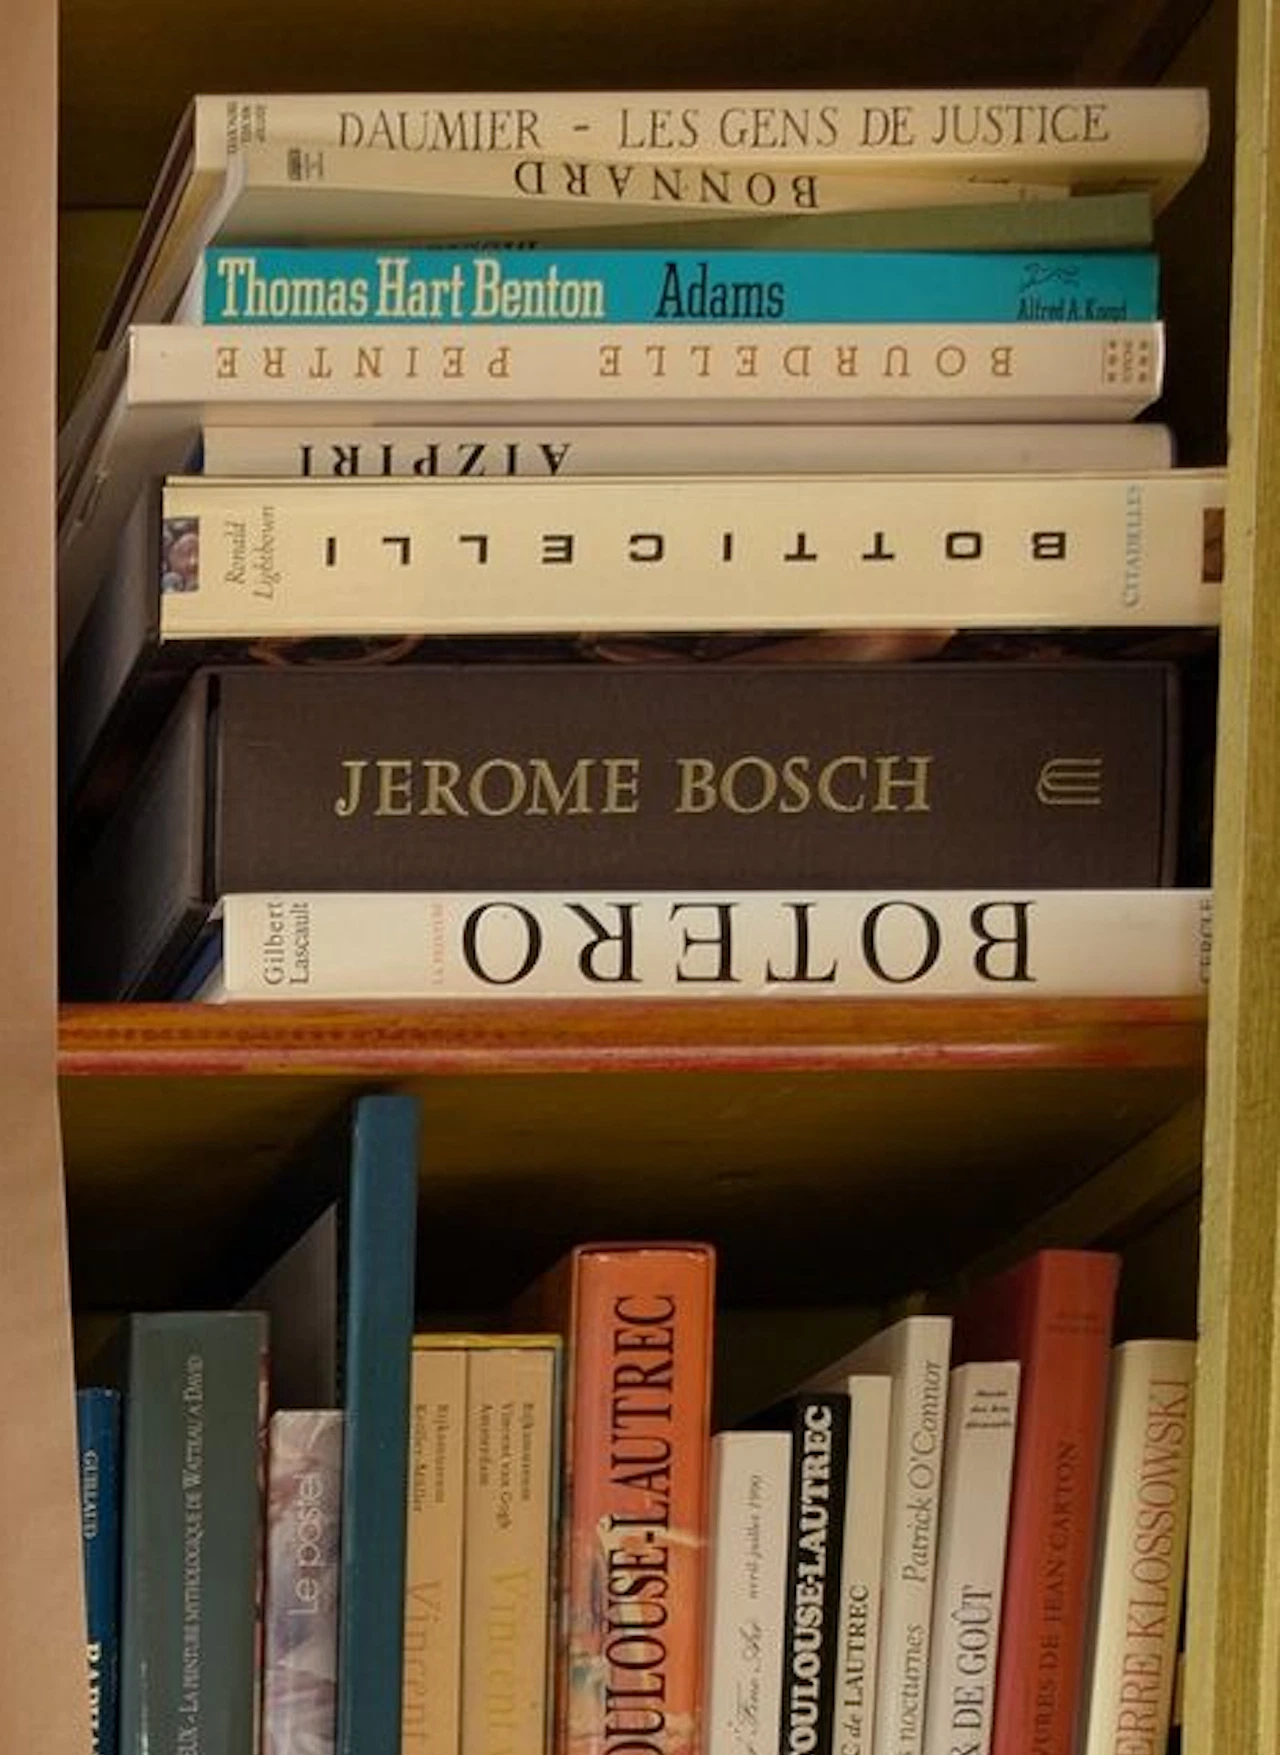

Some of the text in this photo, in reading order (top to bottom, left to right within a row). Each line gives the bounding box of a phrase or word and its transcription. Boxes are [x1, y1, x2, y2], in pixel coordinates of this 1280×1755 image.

[338, 102, 1111, 152] DAUMIER LES GENS DE JUSTICE
[513, 158, 820, 209] BONNARD
[216, 255, 785, 321] Thomas Hart Benton Adams
[216, 344, 1016, 380] BOURDELLE PEINTRE
[324, 529, 1069, 568] BOTTICELLI
[335, 753, 933, 819] JEROME BOSCH
[264, 899, 285, 986] Gilbert
[289, 901, 313, 985] Lascault
[461, 899, 1039, 988] BOTERO
